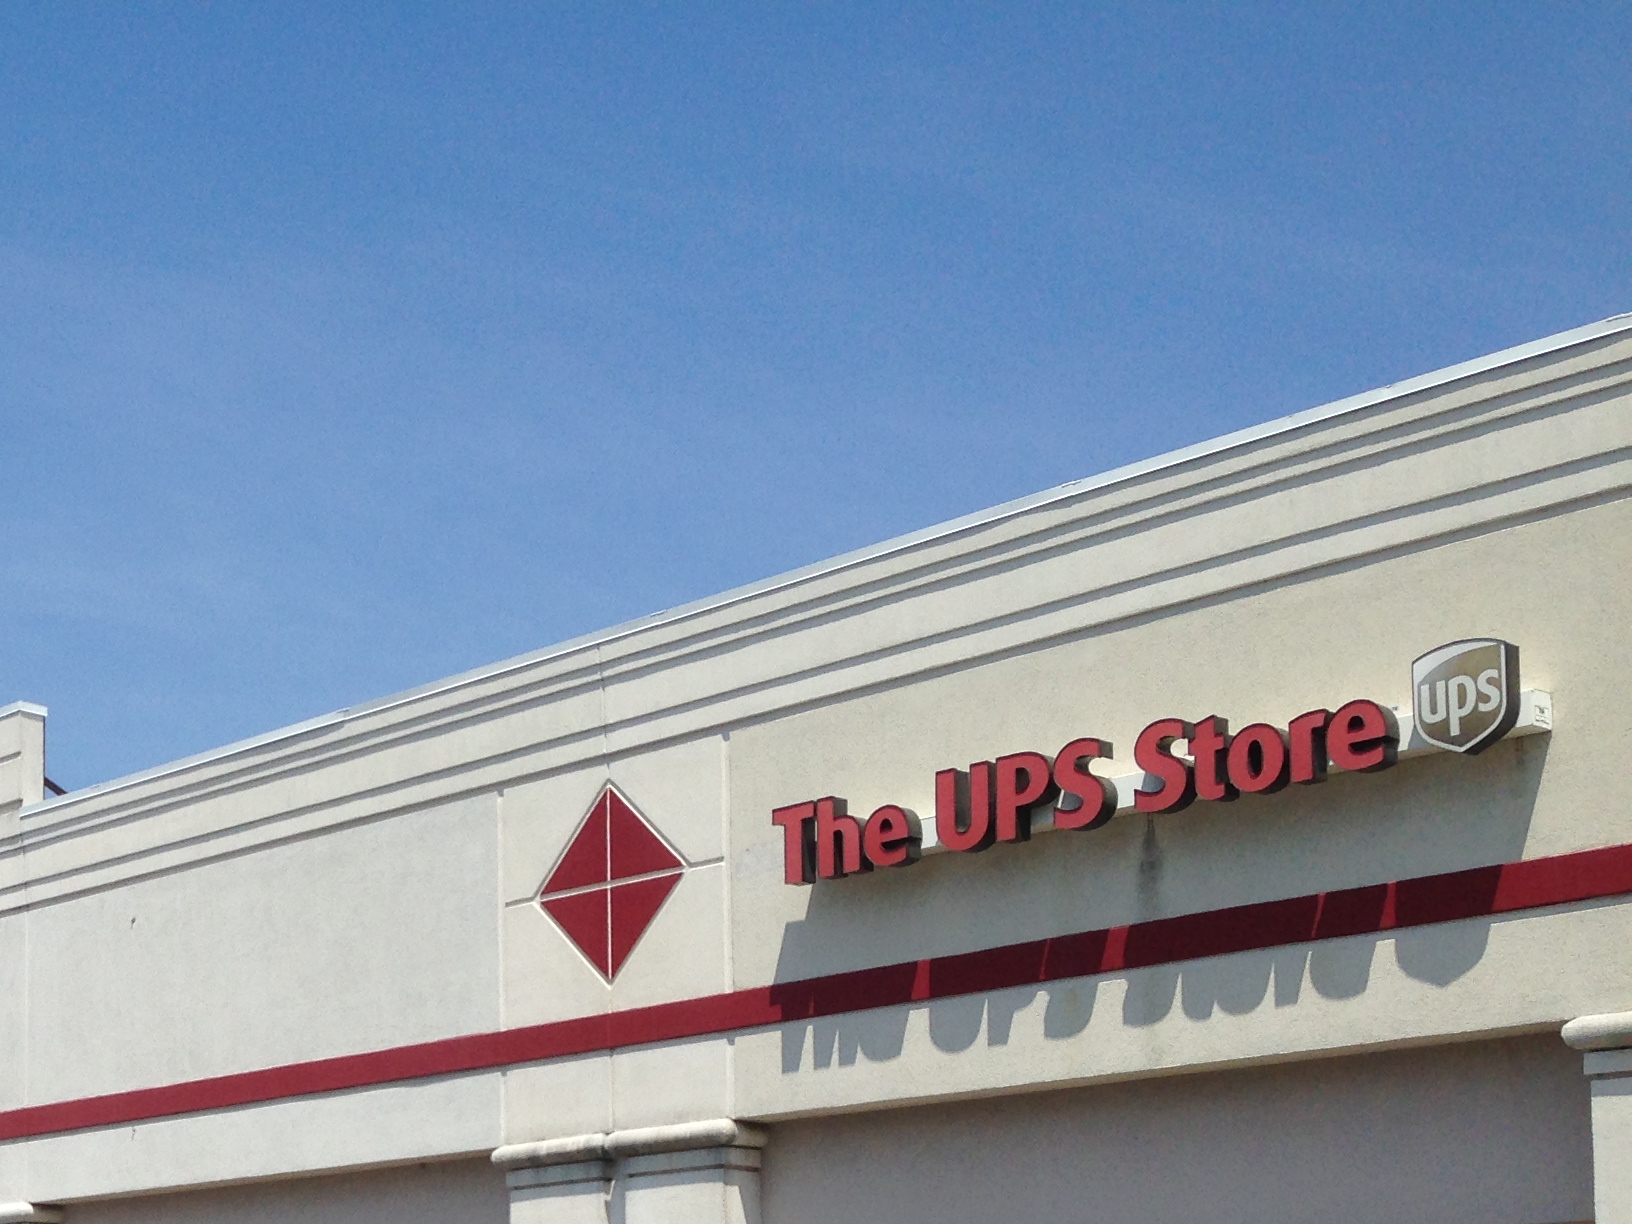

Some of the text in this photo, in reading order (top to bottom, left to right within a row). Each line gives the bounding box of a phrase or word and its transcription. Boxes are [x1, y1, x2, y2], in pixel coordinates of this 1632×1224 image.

[1420, 666, 1502, 738] ups
[772, 698, 1399, 886] The UPS Store
